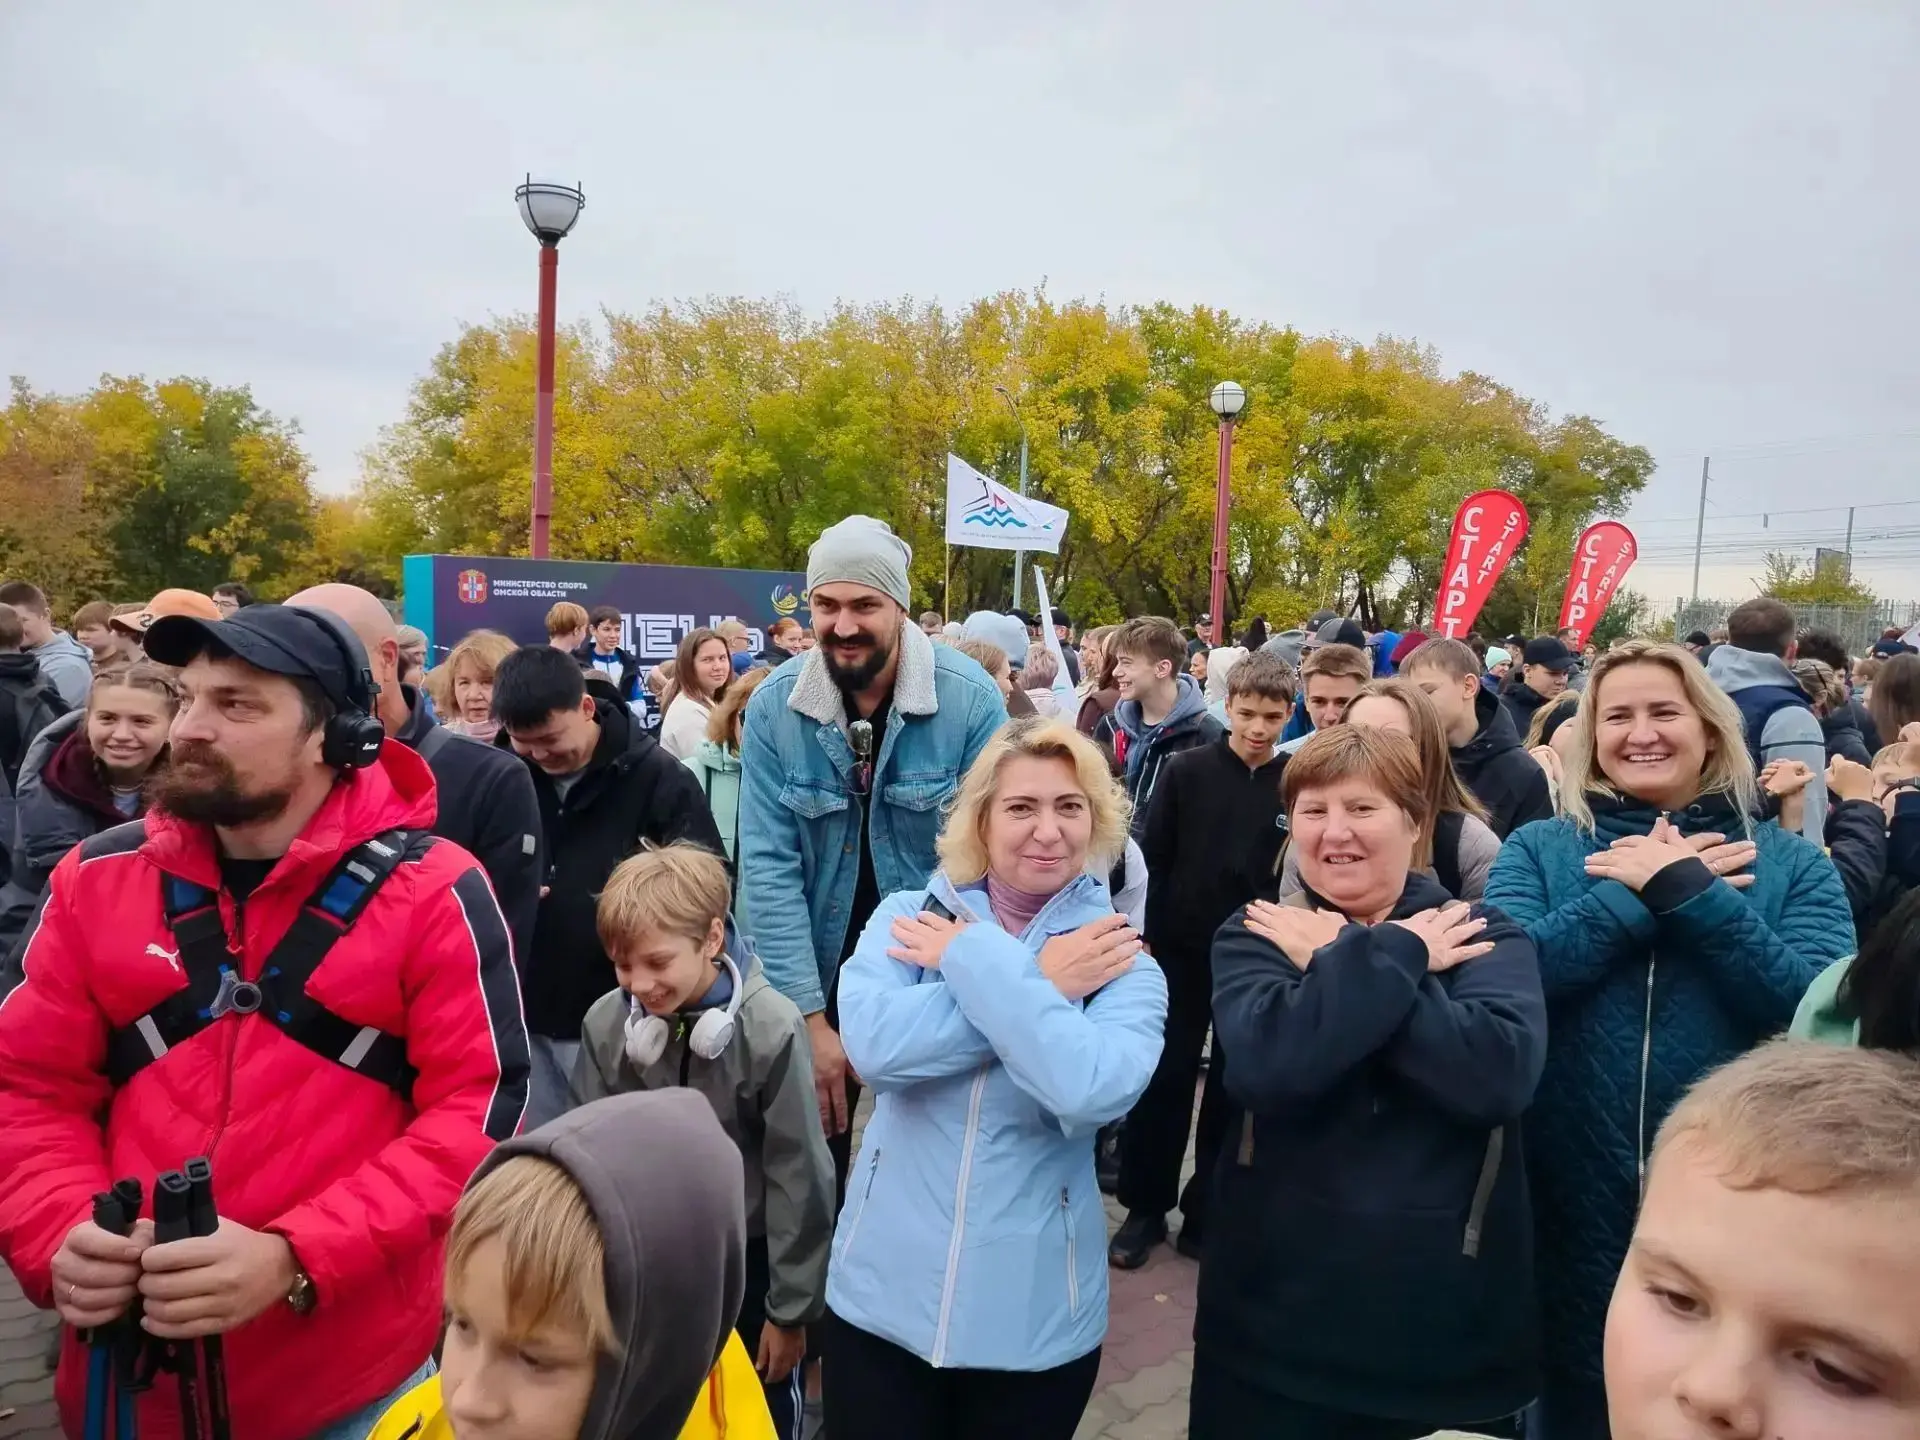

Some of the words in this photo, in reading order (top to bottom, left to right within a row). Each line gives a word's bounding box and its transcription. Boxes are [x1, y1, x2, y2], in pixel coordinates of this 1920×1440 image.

[1442, 506, 1484, 640] СТАРТ
[1475, 511, 1521, 585] START
[1592, 541, 1633, 602] START
[493, 580, 556, 589] МИНИСТЕРСТВО
[557, 582, 588, 590] СПОРТА
[493, 588, 529, 597] ОМСКОЙ
[530, 589, 567, 597] ОБЛАСТИ
